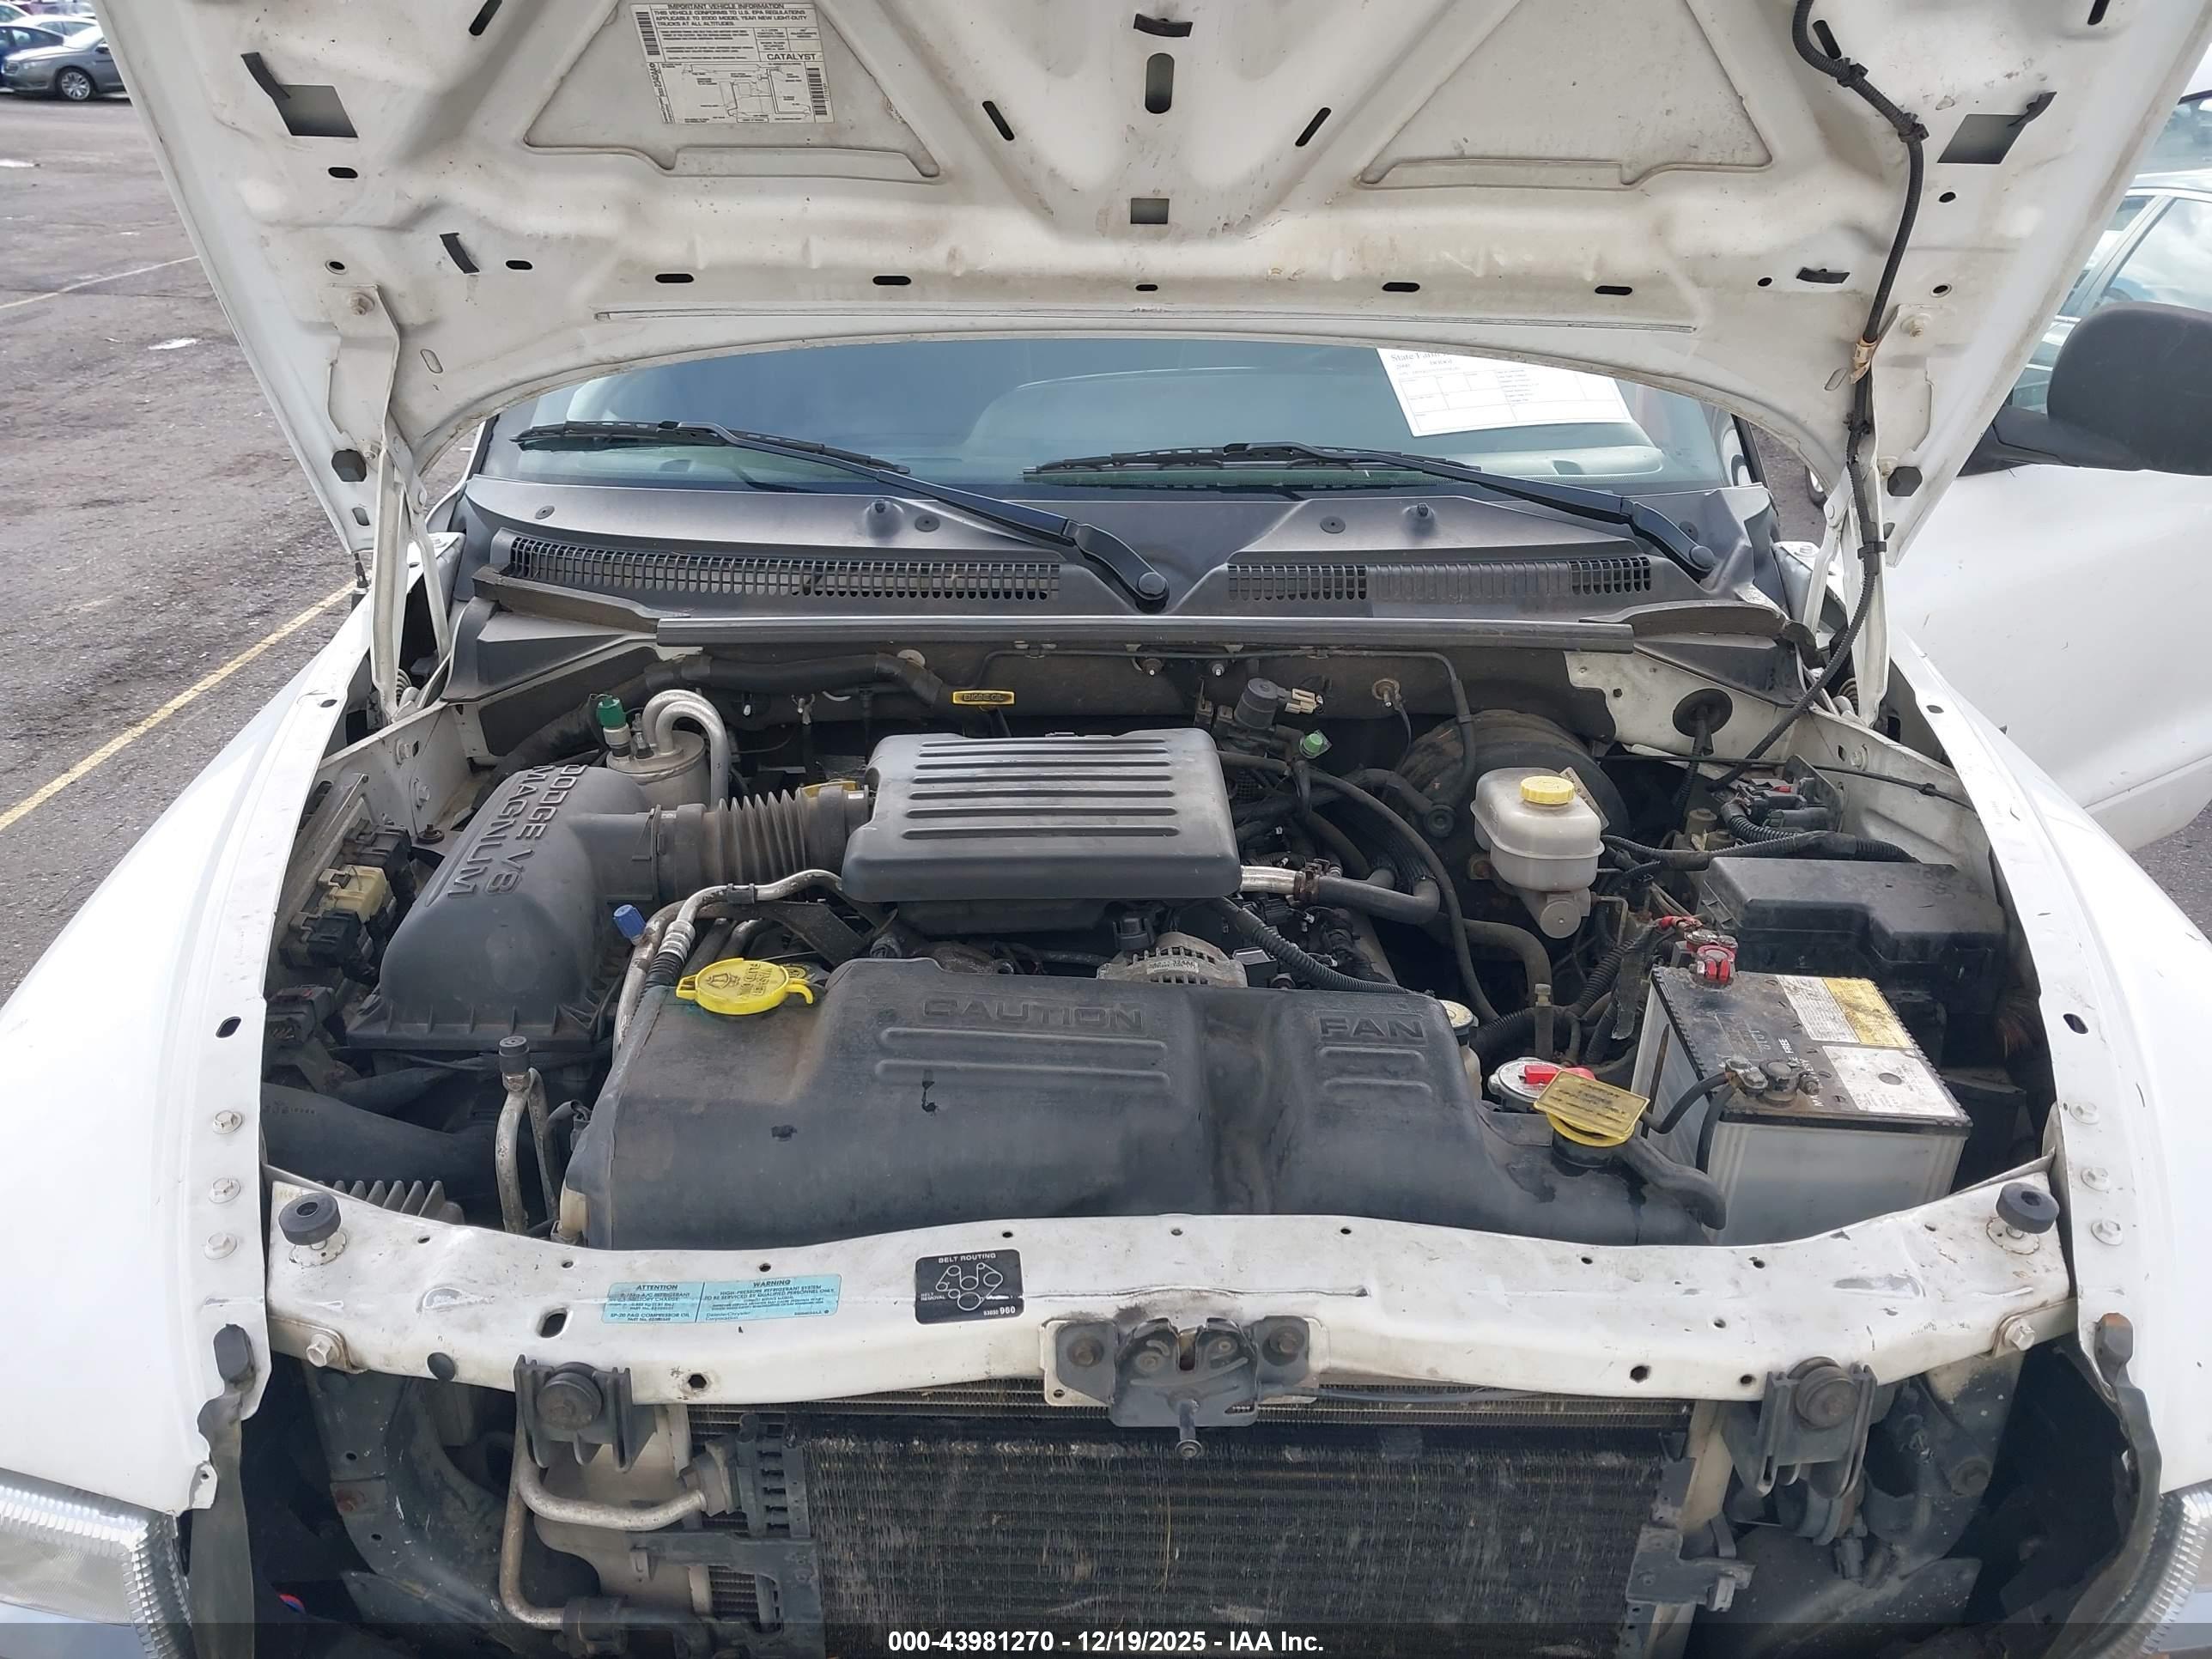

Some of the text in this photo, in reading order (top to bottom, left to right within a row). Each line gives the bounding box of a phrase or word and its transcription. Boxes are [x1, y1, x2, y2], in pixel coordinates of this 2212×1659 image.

[447, 764, 556, 897] MAGNUM
[484, 764, 589, 896] DODGE V8
[922, 1000, 1145, 1030] CAUTION
[1319, 1015, 1425, 1040] FAN
[1778, 1037, 1794, 1054] FREE
[960, 1253, 996, 1261] ROUTING
[1000, 1306, 1016, 1315] 960
